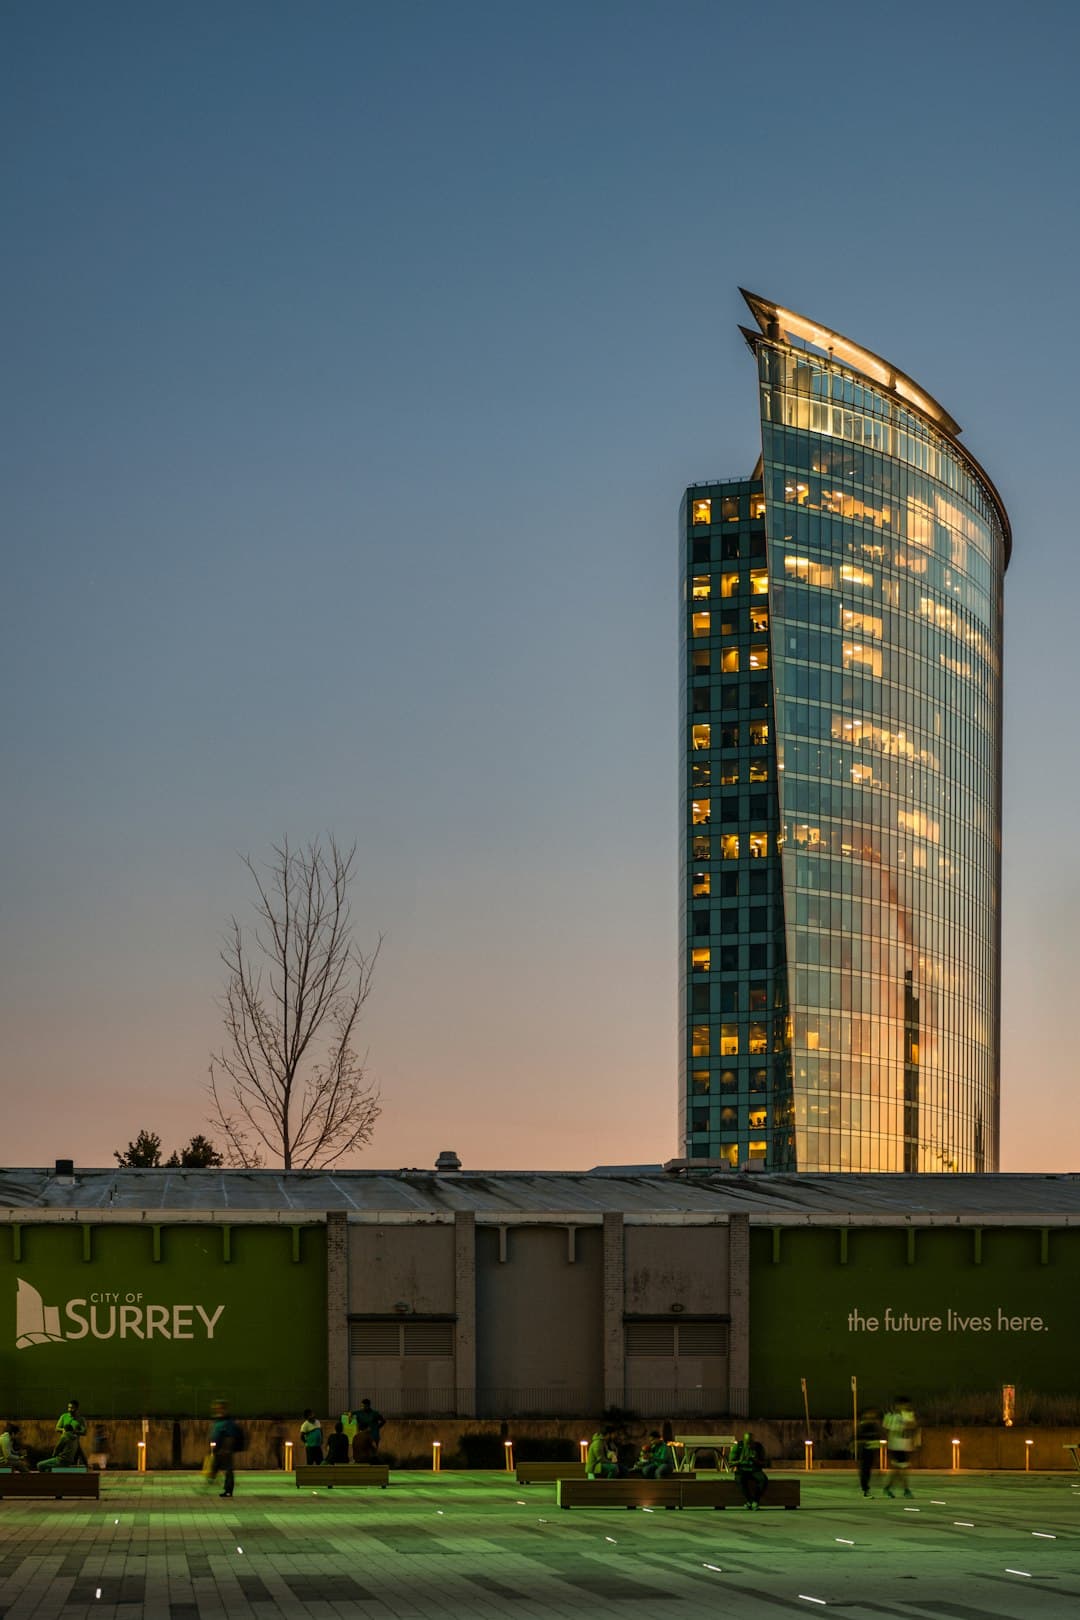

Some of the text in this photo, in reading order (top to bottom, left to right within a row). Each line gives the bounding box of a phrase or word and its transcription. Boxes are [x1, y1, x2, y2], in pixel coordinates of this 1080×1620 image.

[90, 1292, 144, 1303] CITY OF
[65, 1298, 226, 1340] SURREY
[847, 1307, 1049, 1332] the future lives here.
